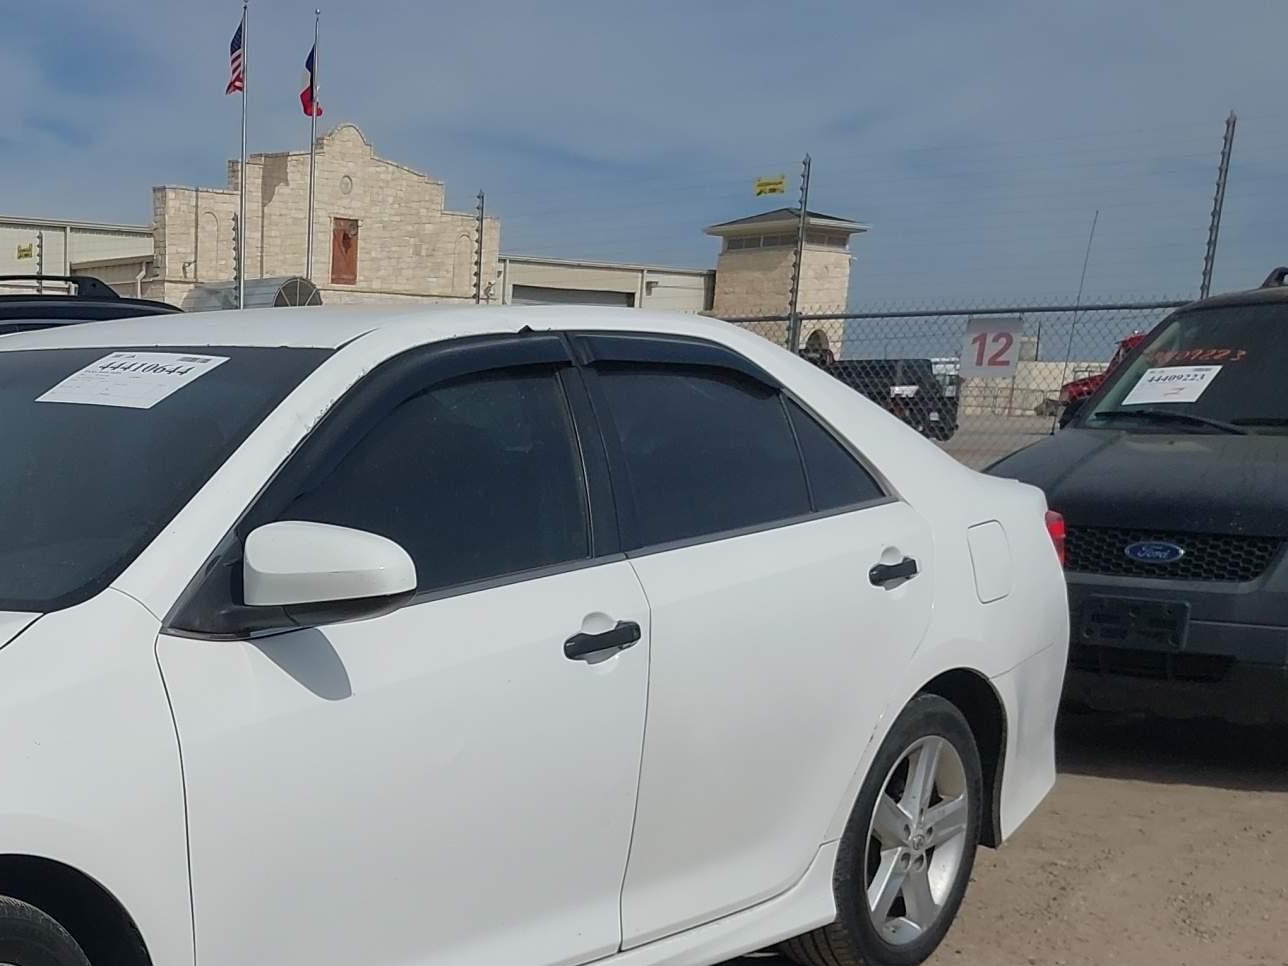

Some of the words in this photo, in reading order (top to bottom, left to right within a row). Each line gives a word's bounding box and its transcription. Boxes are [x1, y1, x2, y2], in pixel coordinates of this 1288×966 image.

[971, 332, 1014, 367] 12
[99, 361, 195, 375] 44410644
[1136, 545, 1172, 558] Ford
